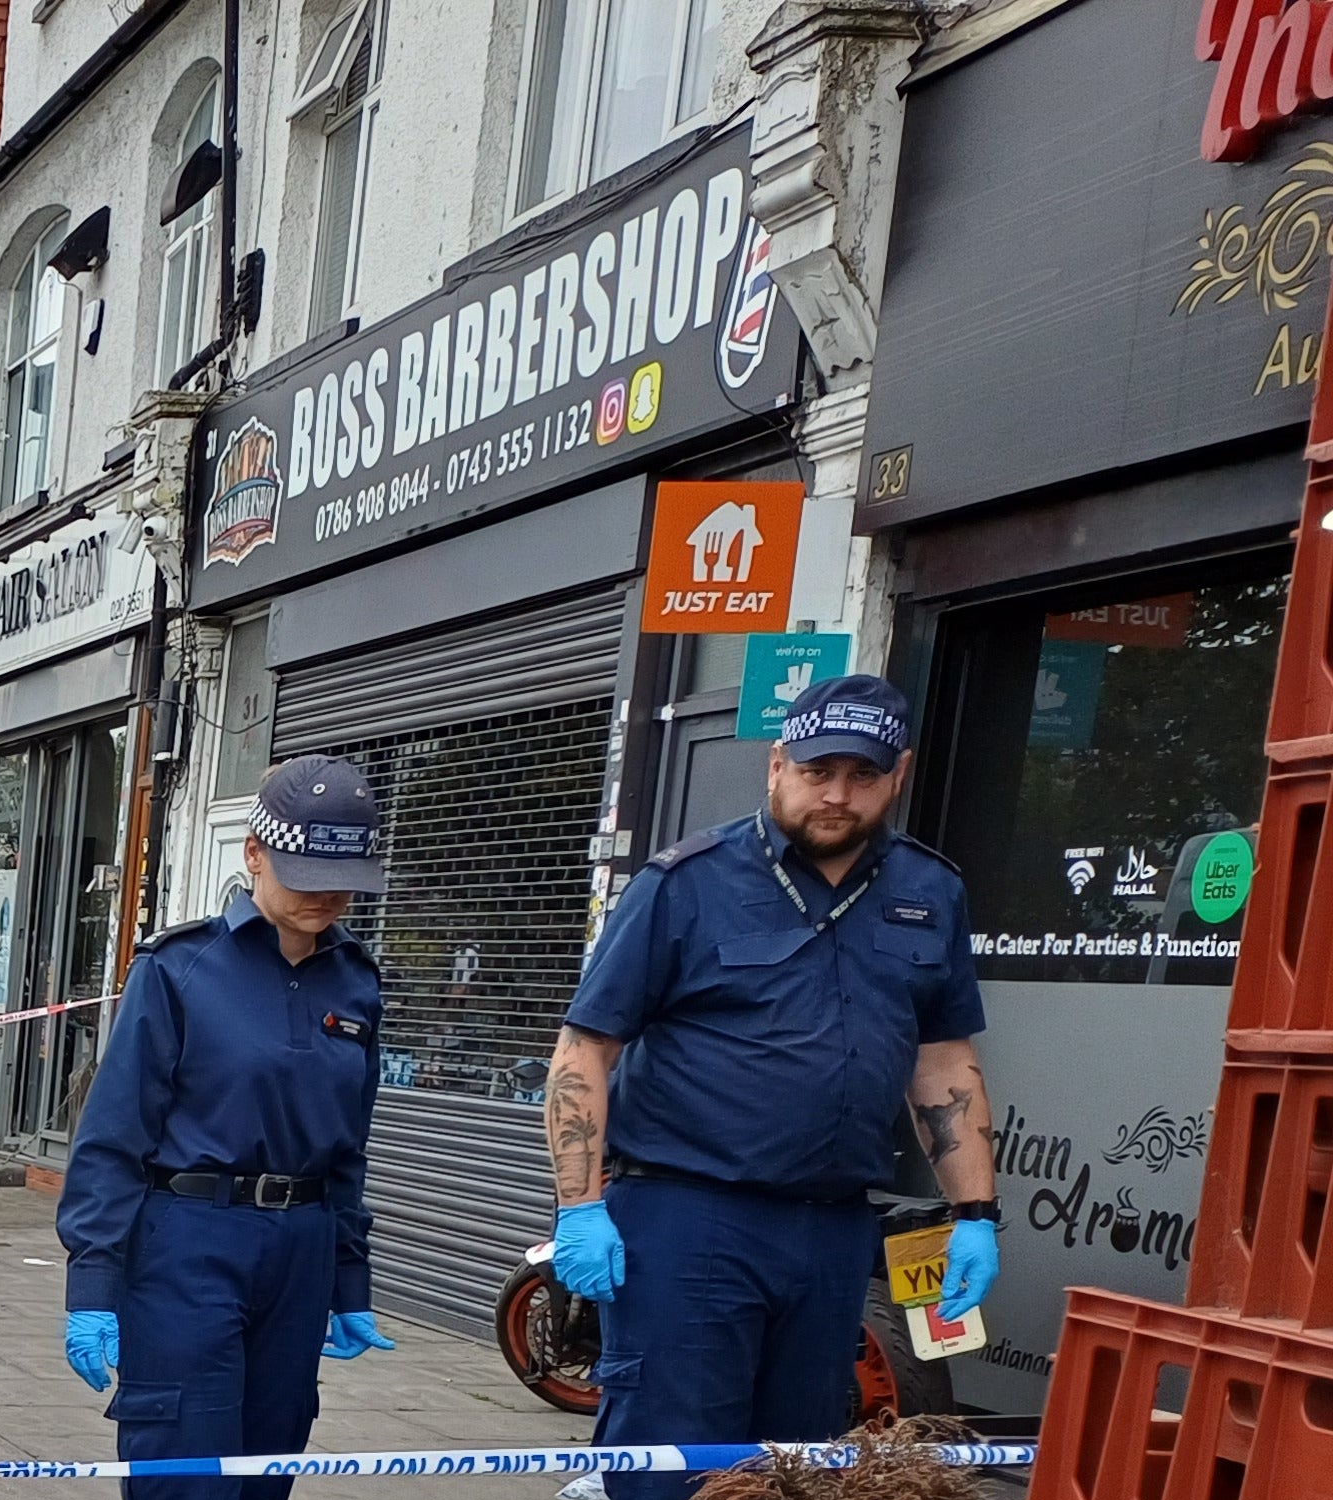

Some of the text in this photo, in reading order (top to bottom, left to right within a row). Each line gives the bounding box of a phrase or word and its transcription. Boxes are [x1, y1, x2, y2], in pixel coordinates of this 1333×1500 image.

[288, 168, 744, 499] BOSS BARBERSHOP
[315, 496, 352, 542] 0786
[356, 482, 386, 527] 908
[388, 464, 431, 517] 8044
[446, 443, 493, 494] 0743
[496, 417, 534, 478] 555
[540, 400, 593, 459] 1132
[875, 452, 908, 498] 33
[661, 592, 774, 615] JUST EAT
[807, 647, 821, 657] on
[243, 693, 258, 720] 31
[822, 721, 879, 734] POLICE OFFICER
[308, 843, 336, 851] POLICE
[1206, 861, 1240, 879] Uber
[1113, 883, 1156, 895] HALAL
[1203, 882, 1236, 899] Eats
[970, 934, 995, 955] We
[996, 934, 1040, 956] Cater
[1042, 934, 1071, 956] For
[1073, 933, 1137, 956] Parties
[1140, 933, 1154, 955] &
